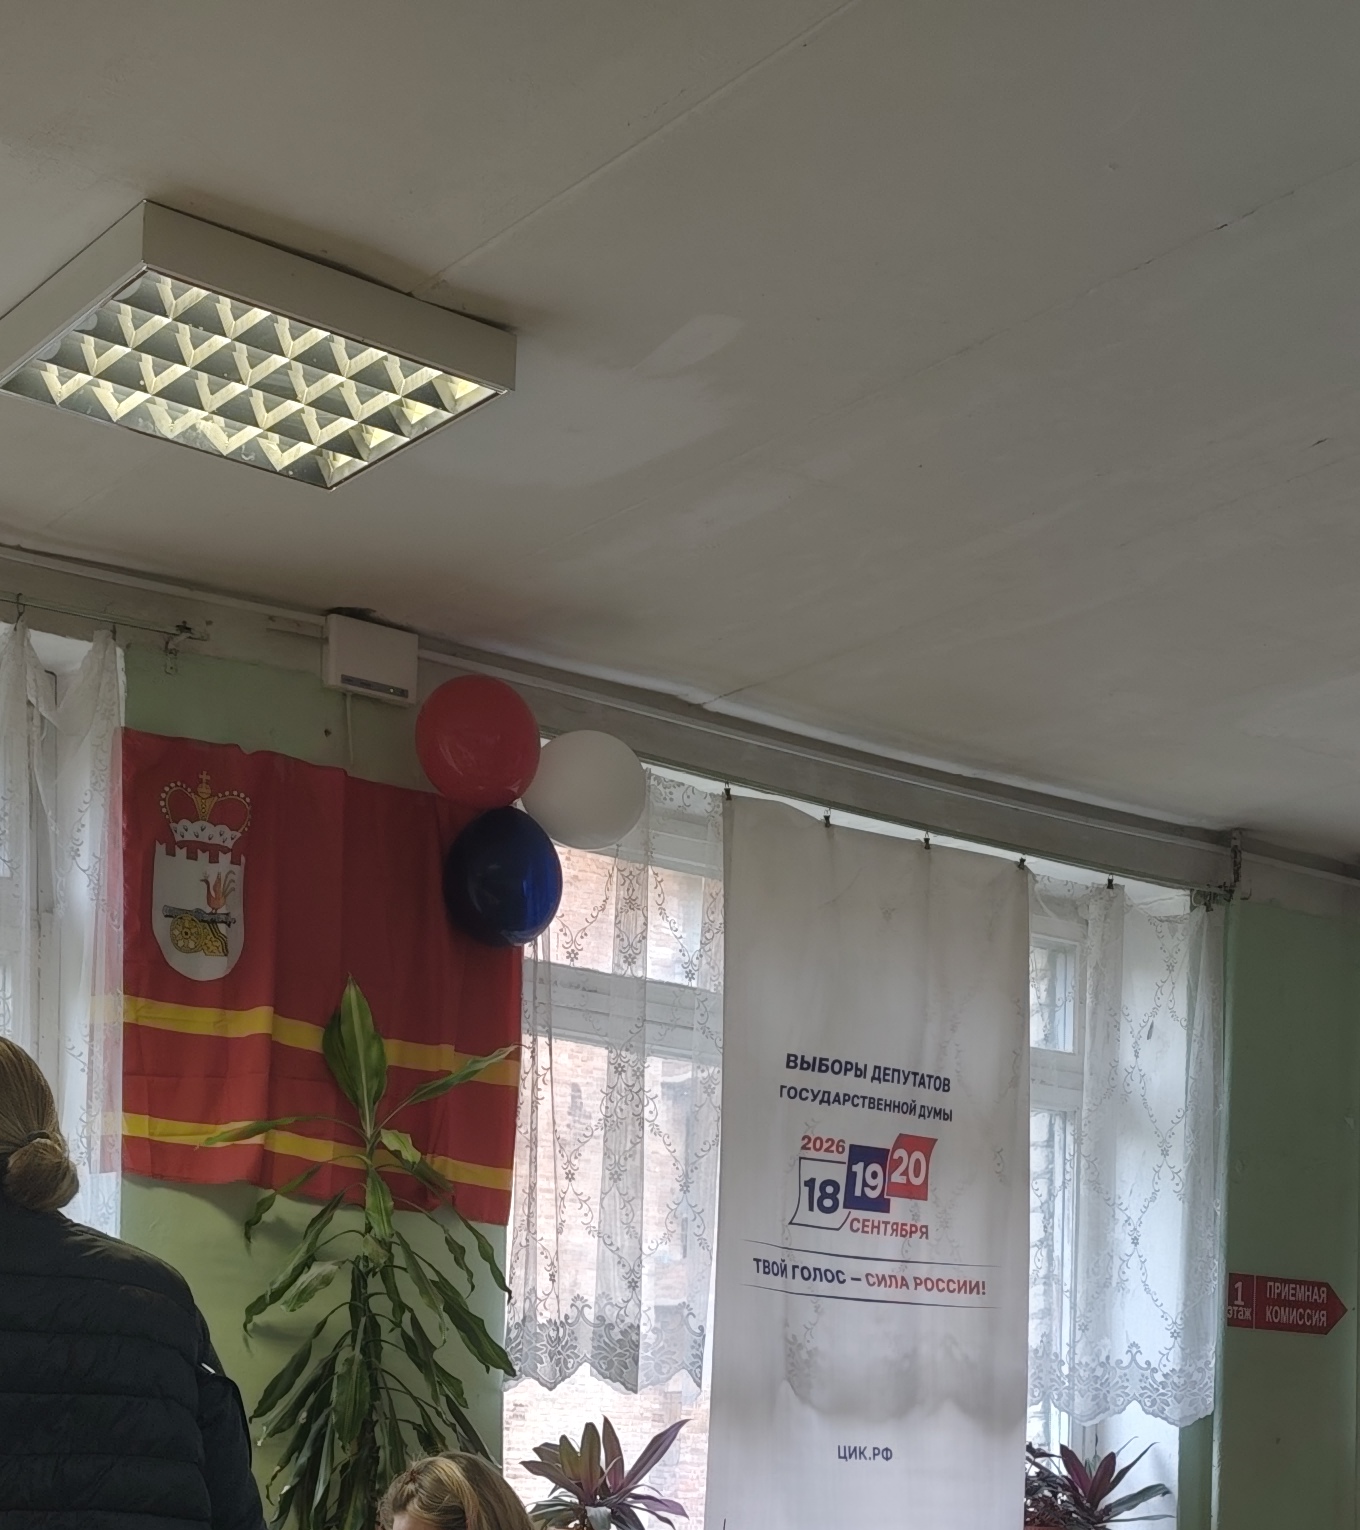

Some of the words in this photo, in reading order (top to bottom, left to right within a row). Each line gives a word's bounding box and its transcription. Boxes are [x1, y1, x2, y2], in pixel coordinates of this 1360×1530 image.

[785, 1053, 868, 1080] ВЫБОРЫ
[870, 1064, 952, 1093] ДЕПУТАТОВ
[779, 1084, 917, 1117] ГОСУДАРСТВЕННОЙ
[918, 1104, 953, 1122] ДУМЫ
[800, 1134, 847, 1154] 2026
[803, 1177, 841, 1214] 18
[851, 1161, 885, 1199] 19
[890, 1148, 927, 1186] 20
[849, 1217, 929, 1240] СЕНТЯБРЯ
[752, 1257, 788, 1279] ТВОЙ
[791, 1264, 847, 1285] ГОЛОС
[864, 1272, 910, 1291] СИЛА
[913, 1276, 987, 1296] РОССИИ!
[1234, 1281, 1245, 1306] 1
[1266, 1281, 1327, 1304] ПРИЕМНАЯ
[1227, 1305, 1252, 1321] этаж
[1265, 1305, 1327, 1327] КОМИССИЯ
[837, 1444, 893, 1462] ЦИК.РФ
